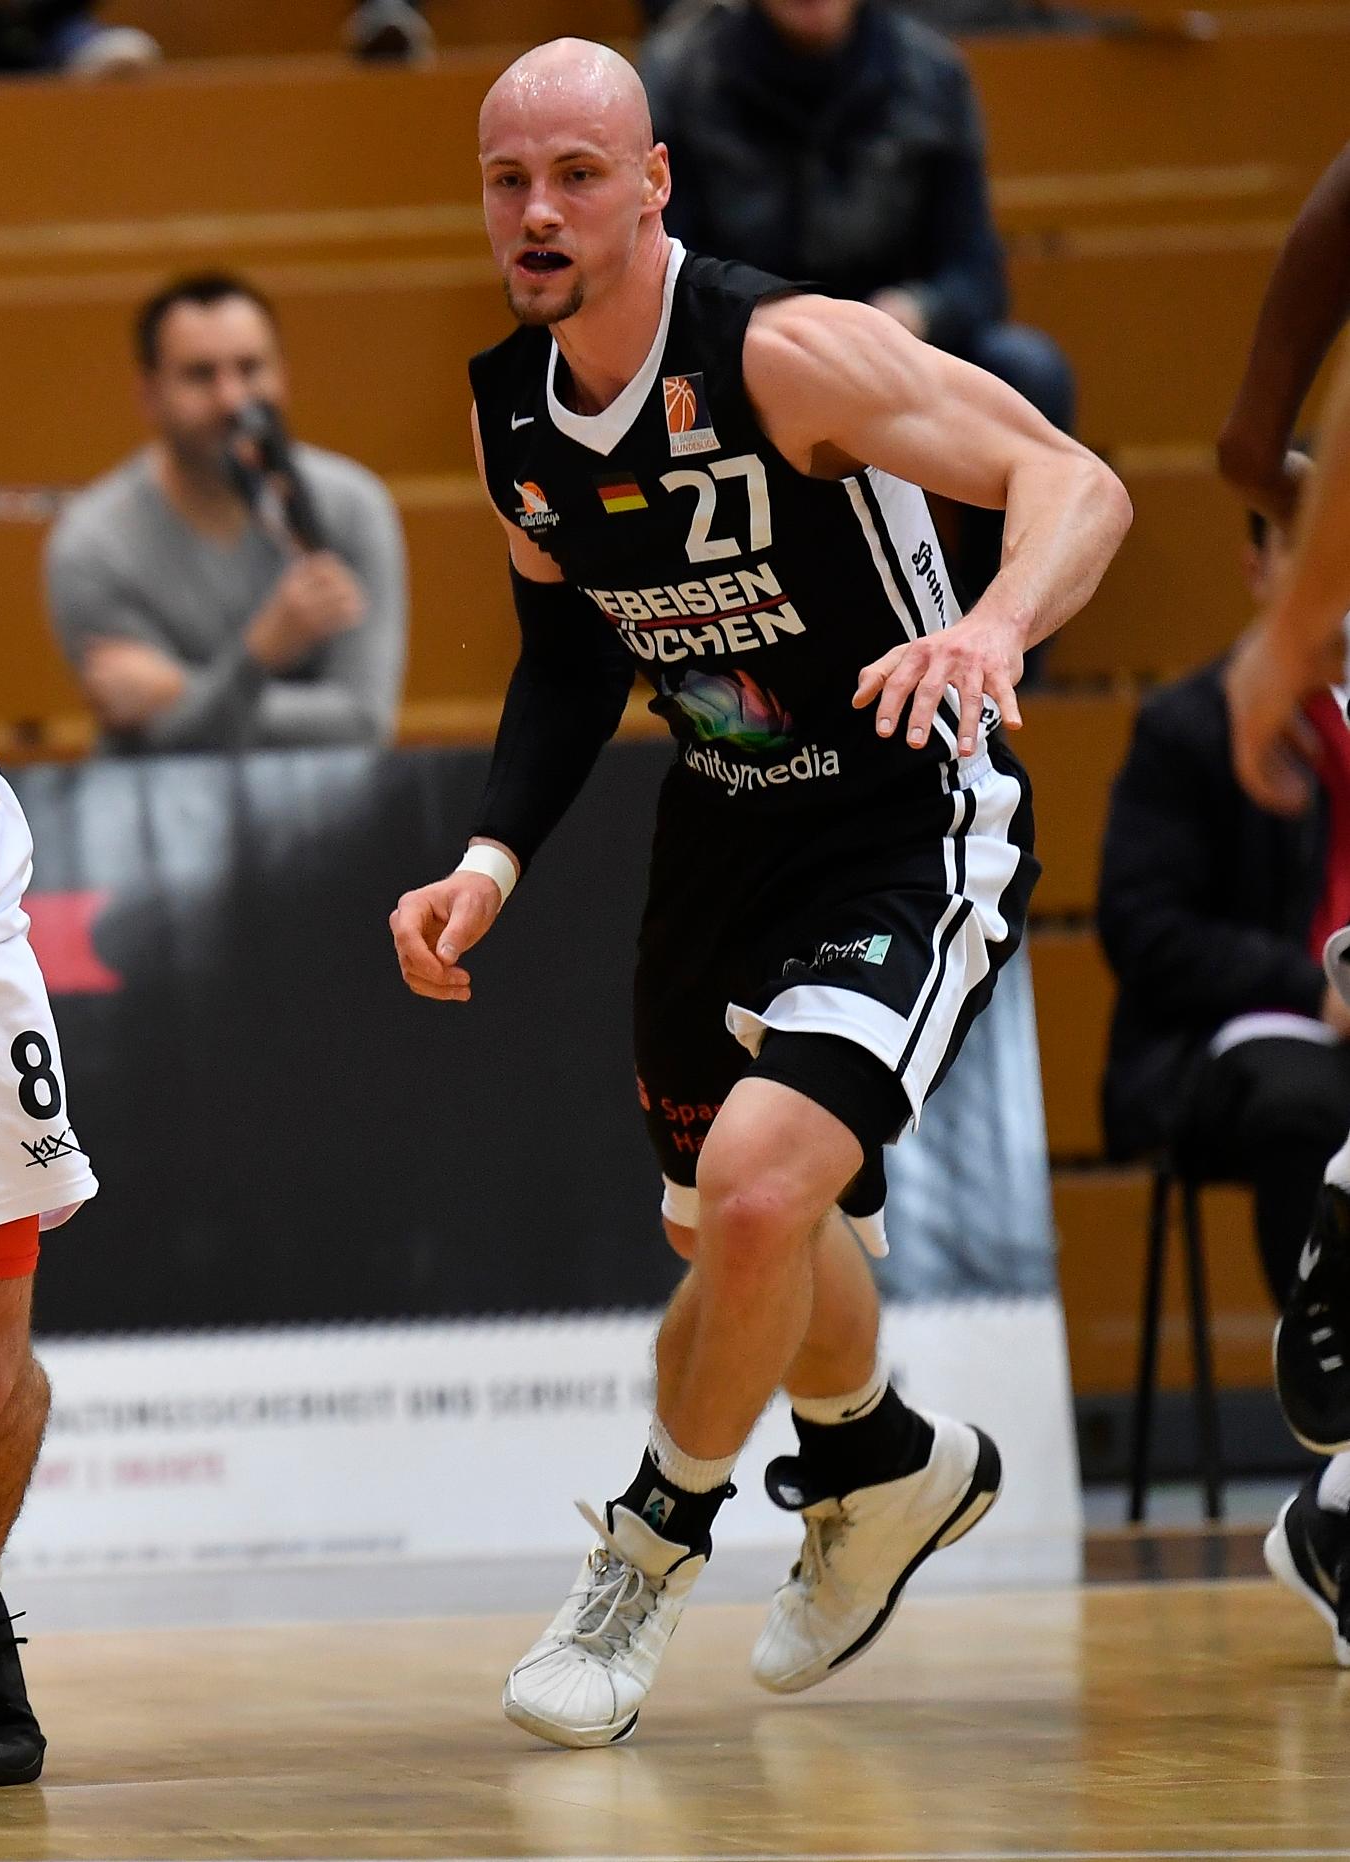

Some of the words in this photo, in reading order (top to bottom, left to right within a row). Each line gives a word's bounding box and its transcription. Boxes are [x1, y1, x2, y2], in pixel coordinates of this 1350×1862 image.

[659, 453, 772, 563] 27
[684, 744, 840, 797] unitymedia
[10, 1030, 62, 1120] 8
[407, 1382, 475, 1419] UND
[487, 1376, 619, 1413] SERVICE
